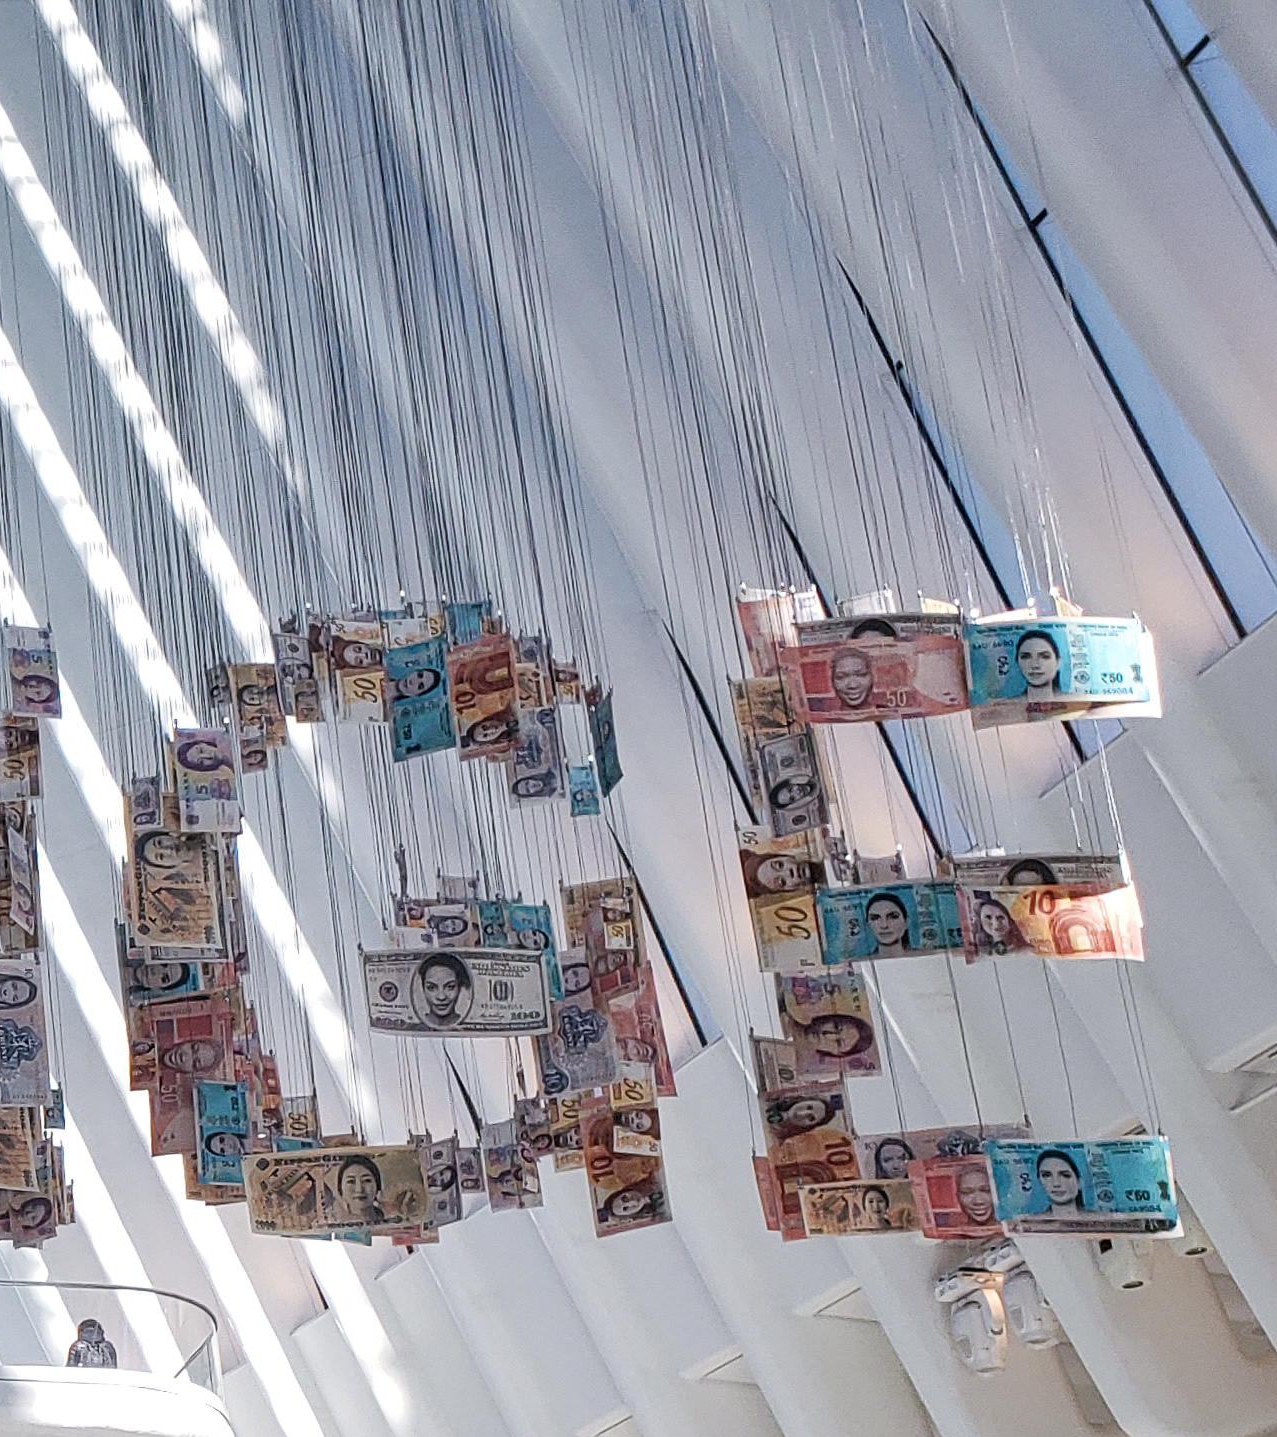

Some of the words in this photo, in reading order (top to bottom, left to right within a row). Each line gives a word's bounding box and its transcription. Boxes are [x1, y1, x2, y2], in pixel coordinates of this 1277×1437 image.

[353, 677, 378, 704] 50
[885, 690, 908, 708] 50
[455, 691, 477, 715] 10
[3, 759, 25, 780] 50
[1023, 889, 1056, 917] 10
[776, 906, 811, 940] 50
[510, 1010, 541, 1021] 100
[623, 1077, 644, 1102] 50
[561, 1098, 579, 1119] 50
[289, 1112, 308, 1130] 50
[824, 1137, 855, 1166] 10
[590, 1156, 614, 1183] 10
